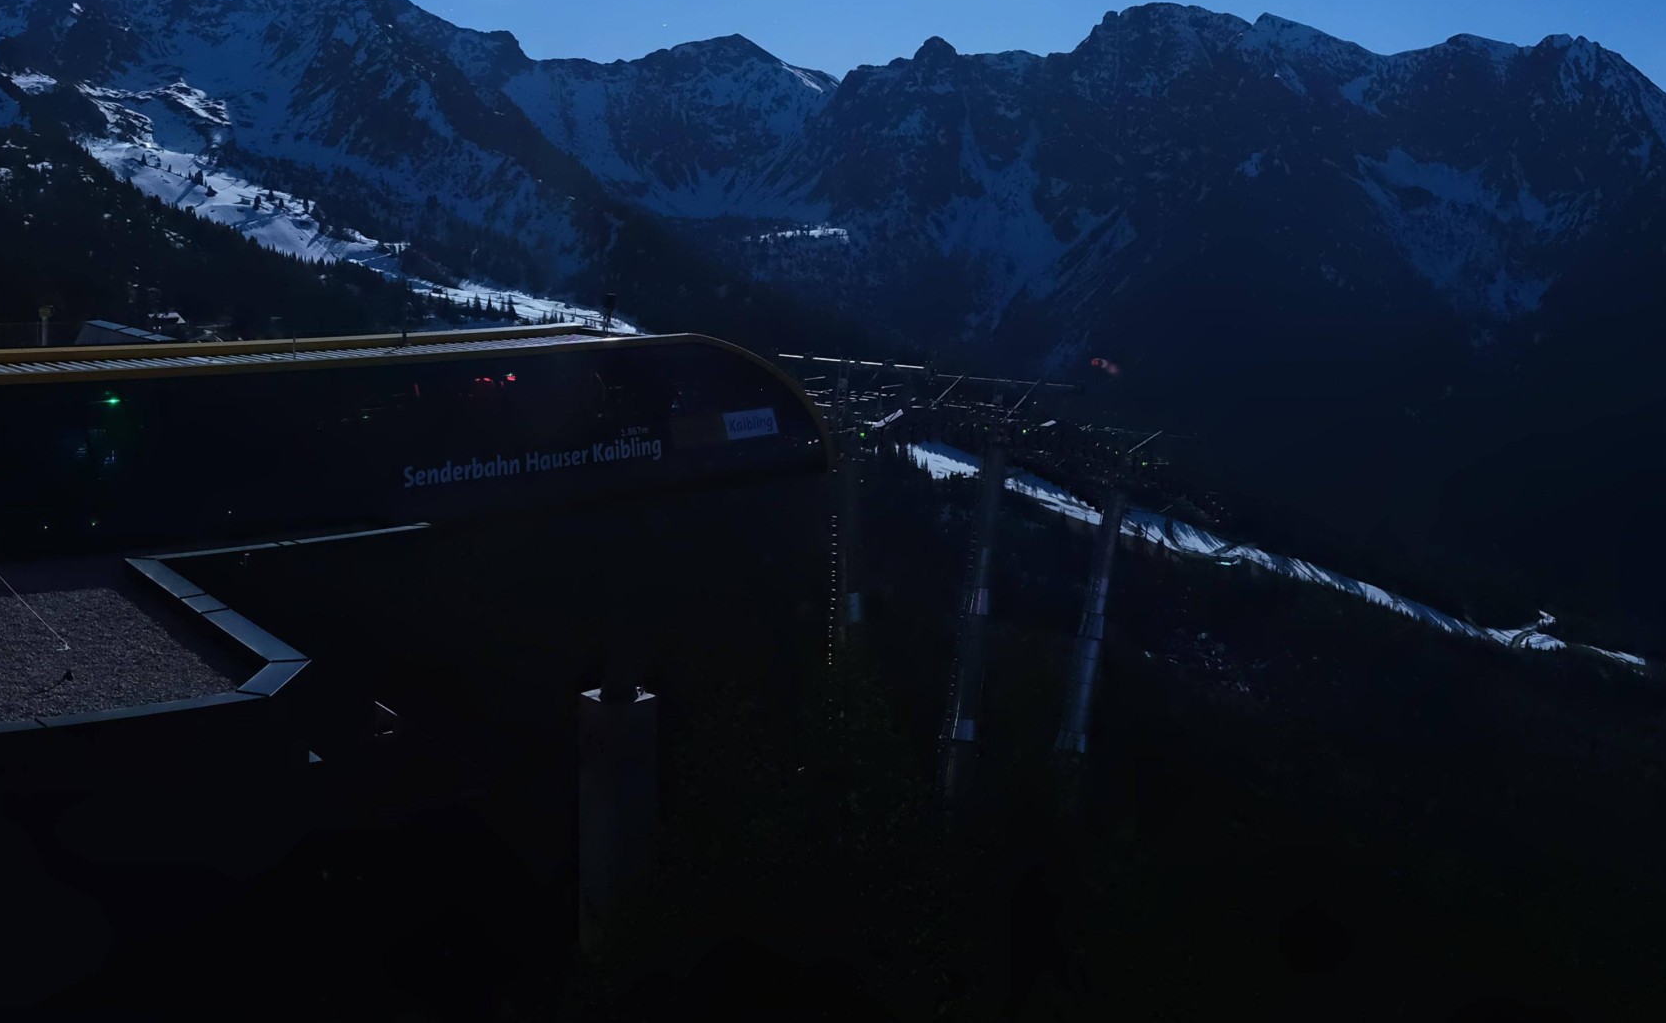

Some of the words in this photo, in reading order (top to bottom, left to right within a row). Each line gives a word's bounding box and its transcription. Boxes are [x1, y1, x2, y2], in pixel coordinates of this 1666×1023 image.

[728, 414, 774, 434] Kaibling
[403, 453, 521, 488] Senderbahn
[525, 446, 589, 474] Hauser
[592, 436, 662, 463] Kaibling
